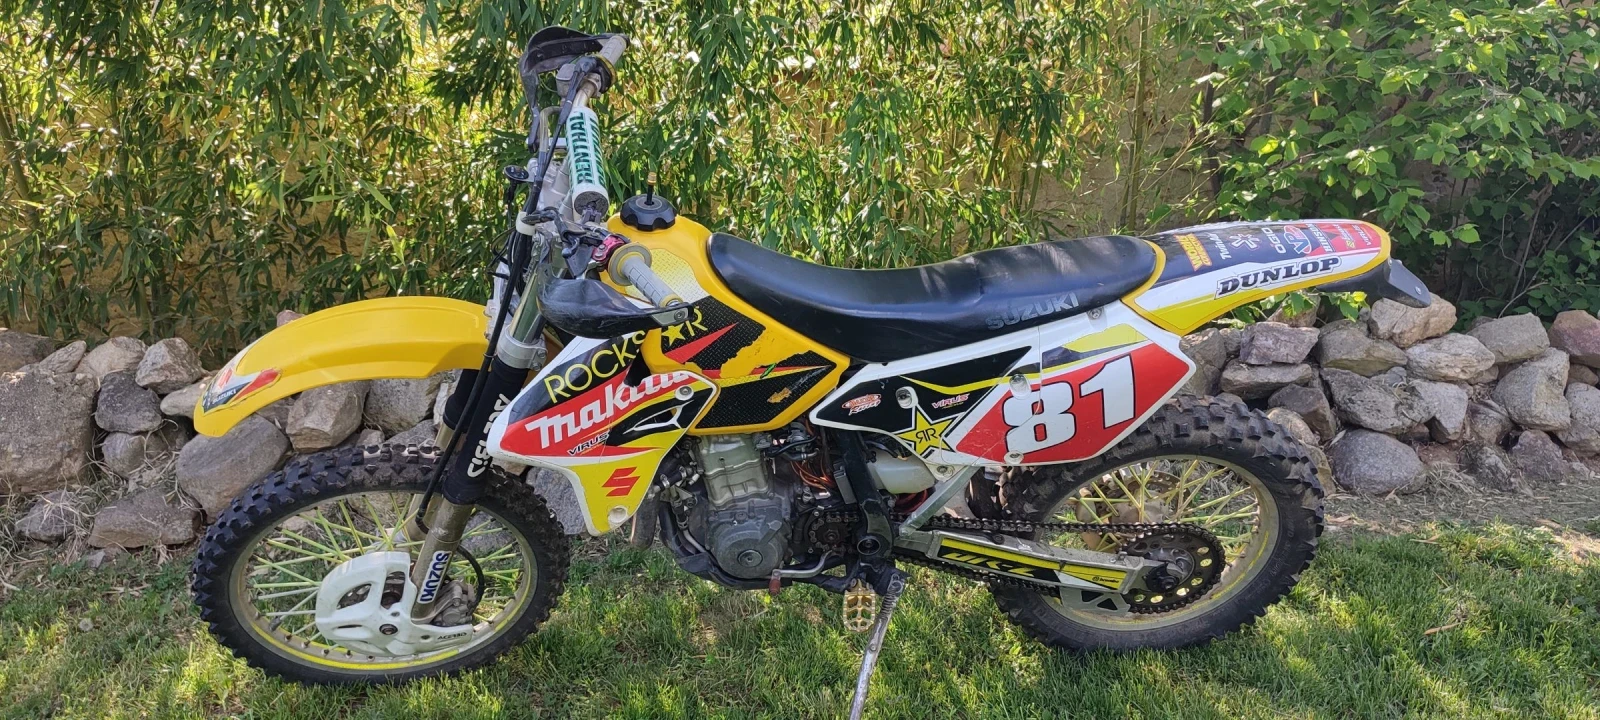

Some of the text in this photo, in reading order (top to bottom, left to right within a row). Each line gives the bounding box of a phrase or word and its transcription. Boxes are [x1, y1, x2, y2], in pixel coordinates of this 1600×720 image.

[569, 112, 593, 184] RENTHAL
[1261, 227, 1287, 254] OGIO
[1217, 256, 1341, 297] DUNLOP
[985, 292, 1079, 330] SUZUKI
[1003, 354, 1136, 456] 81
[567, 430, 612, 456] VIRUS
[419, 552, 449, 602] SUZUKI
